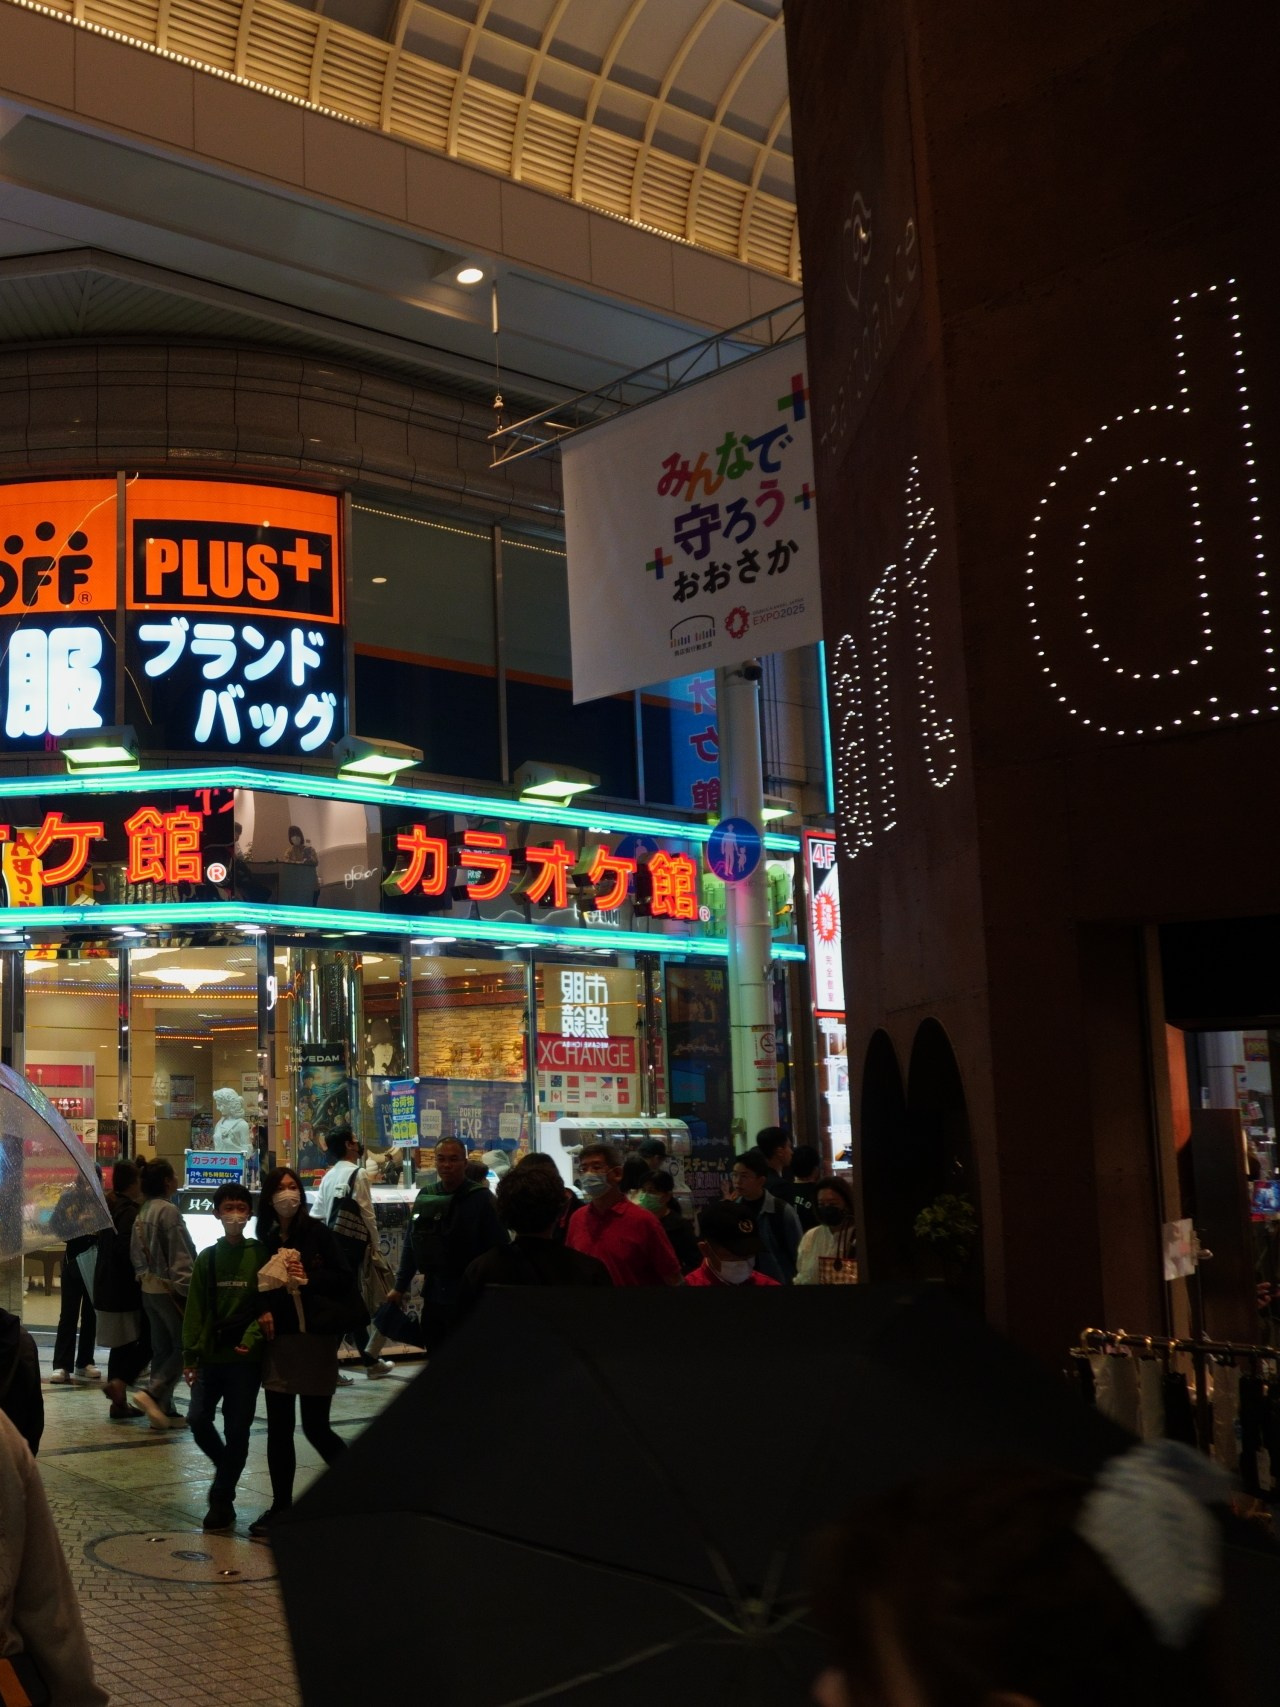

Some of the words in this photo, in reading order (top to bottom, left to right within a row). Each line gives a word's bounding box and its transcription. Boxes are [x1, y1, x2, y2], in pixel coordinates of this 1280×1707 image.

[657, 423, 794, 501] みんなで
[673, 479, 785, 560] 守ろう
[672, 539, 800, 604] おおさか
[753, 603, 805, 626] EXPO2025
[139, 616, 325, 687] ブランド
[195, 683, 337, 752] バッグ
[396, 823, 700, 922] カラオケ館
[812, 842, 836, 869] 4F
[459, 1107, 482, 1118] PORTER
[192, 1156, 238, 1166] カラオケ館
[188, 1198, 215, 1211] 只今
